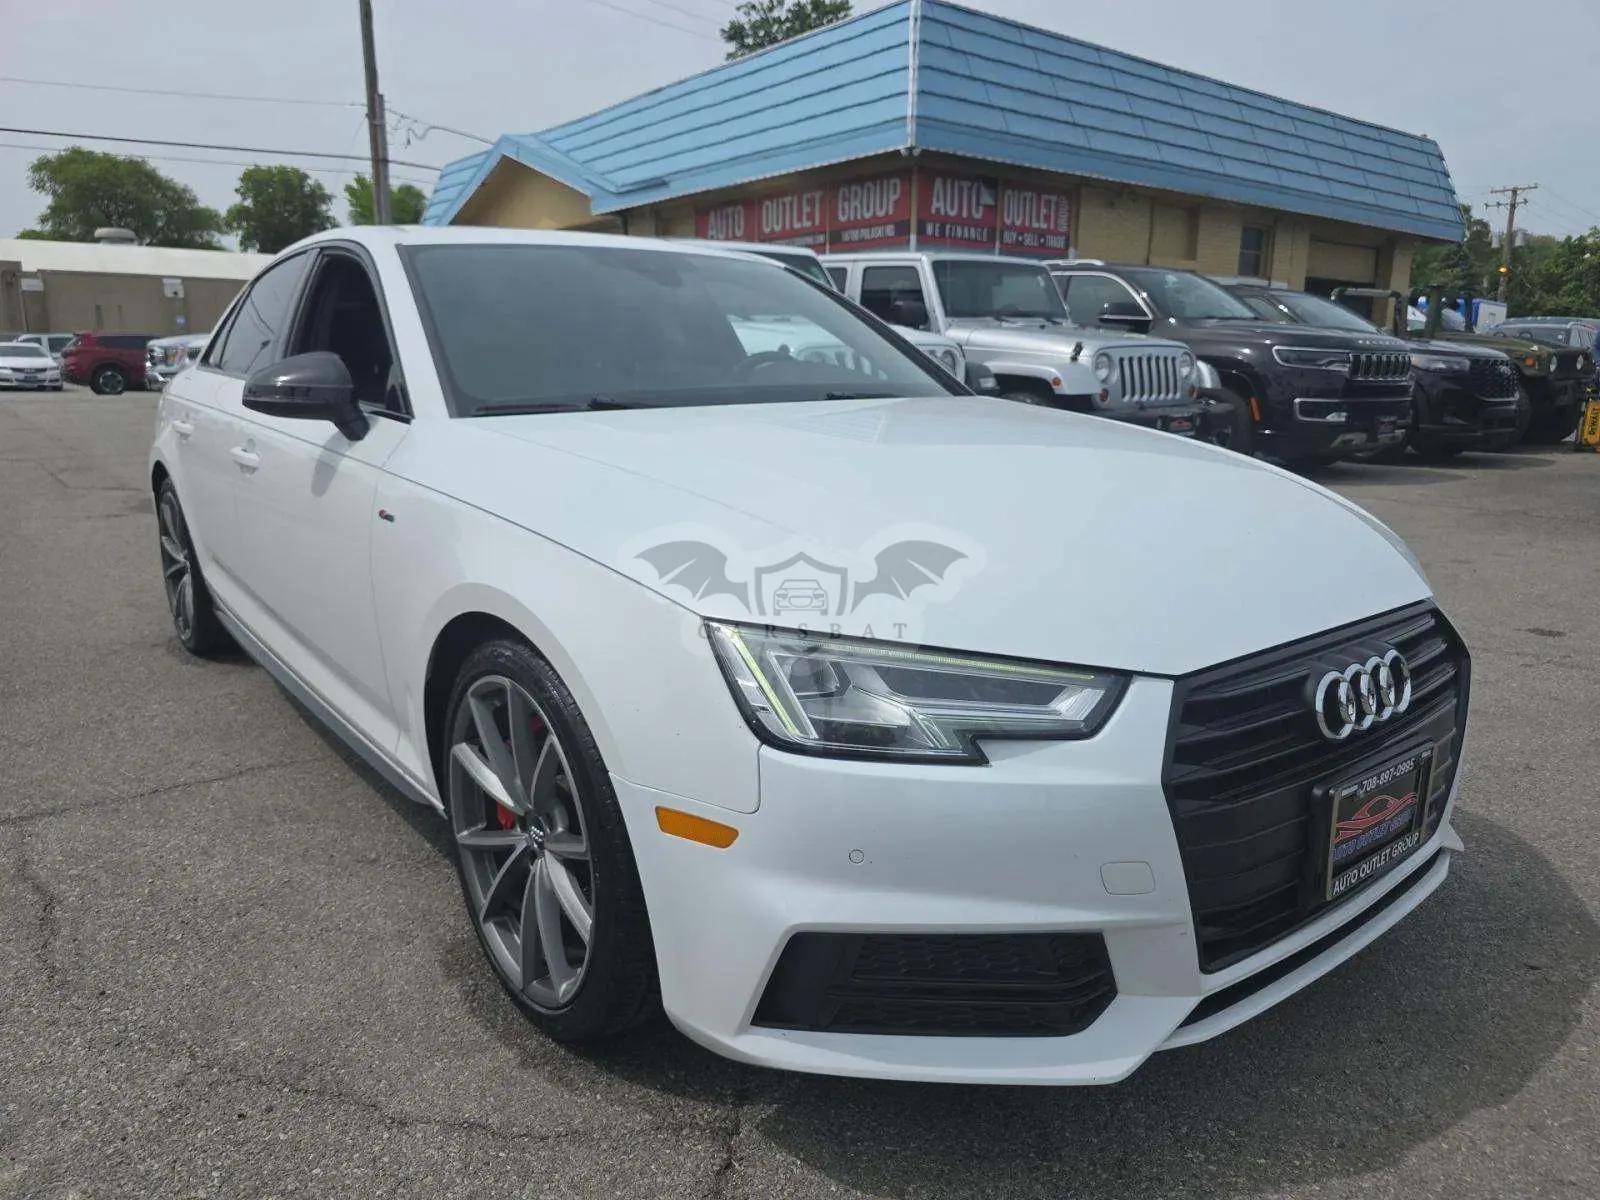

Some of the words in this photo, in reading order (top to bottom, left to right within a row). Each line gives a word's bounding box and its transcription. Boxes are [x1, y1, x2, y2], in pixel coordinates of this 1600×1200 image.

[708, 204, 745, 240] AUTO
[762, 191, 823, 234] OUTLET
[838, 178, 900, 222] GROUP
[931, 177, 984, 219] AUTO
[1004, 189, 1058, 229] OUTLET
[926, 222, 940, 237] WE
[945, 223, 988, 242] FINANCE
[1332, 869, 1359, 896] AUTO
[1359, 848, 1391, 877] OUTLET
[1391, 832, 1420, 858] GROUP
